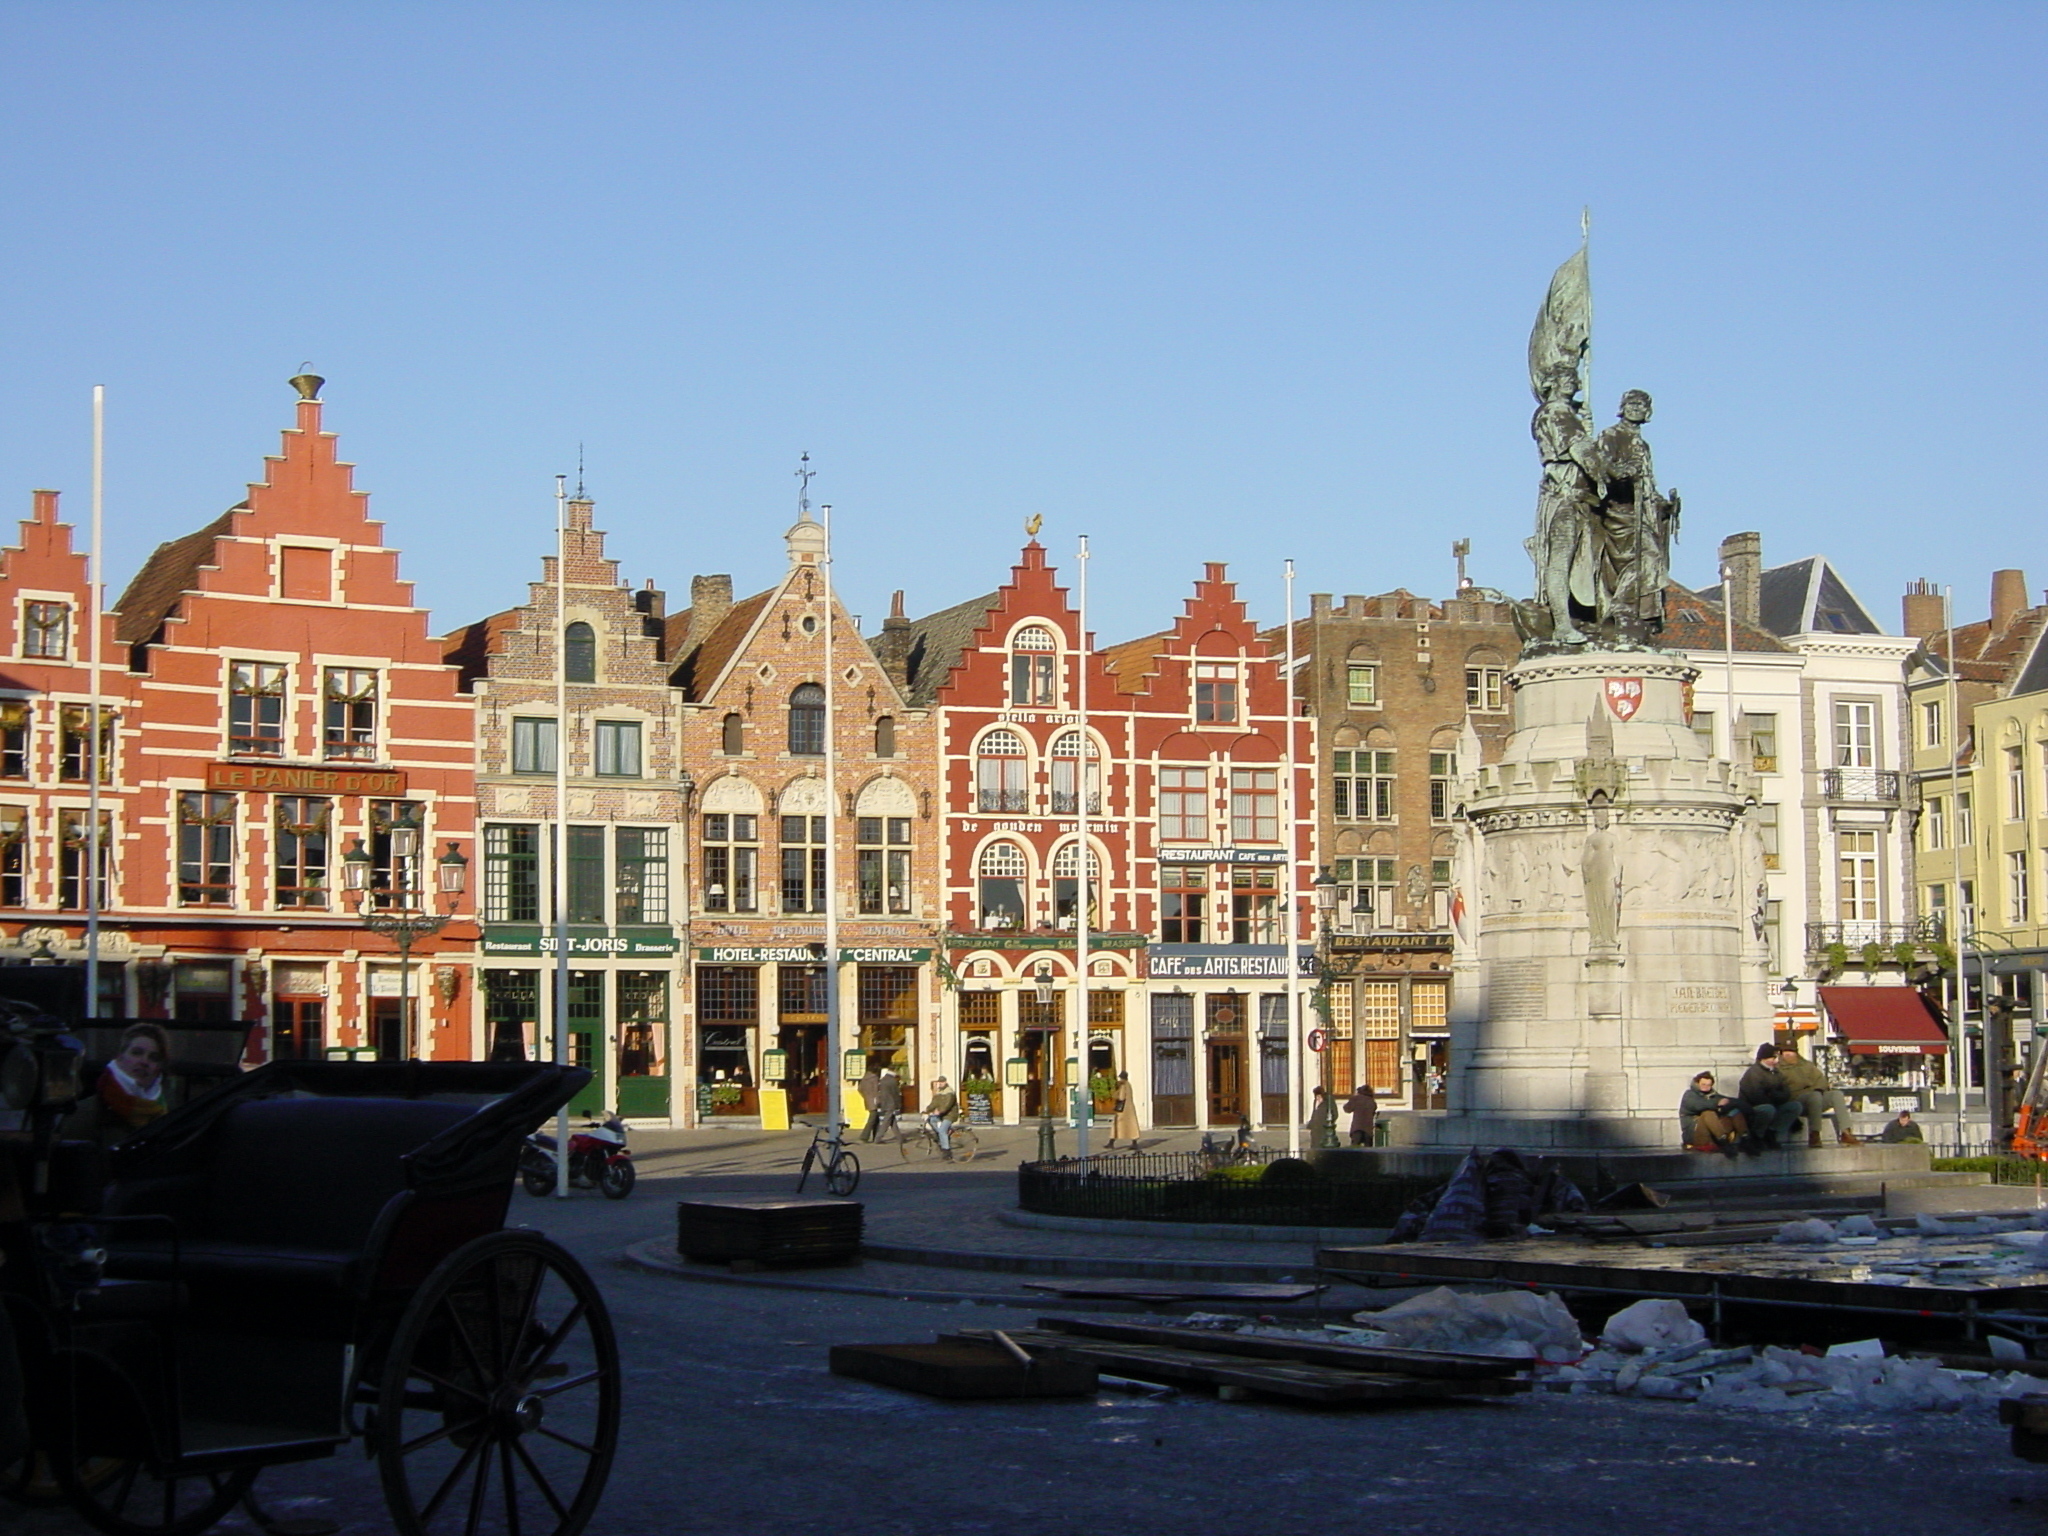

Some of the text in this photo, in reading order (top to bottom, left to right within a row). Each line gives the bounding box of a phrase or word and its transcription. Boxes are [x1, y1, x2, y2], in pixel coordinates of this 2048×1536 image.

[998, 713, 1089, 724] stella artoi
[215, 771, 245, 786] LE
[251, 769, 338, 790] PANIER
[962, 820, 1118, 833] de gouden mermin
[1161, 850, 1236, 861] RESTAURANT
[486, 942, 532, 950] Restaurant
[1335, 936, 1428, 946] RESTAURANT
[1879, 1045, 1921, 1053] SOUVENIRS
